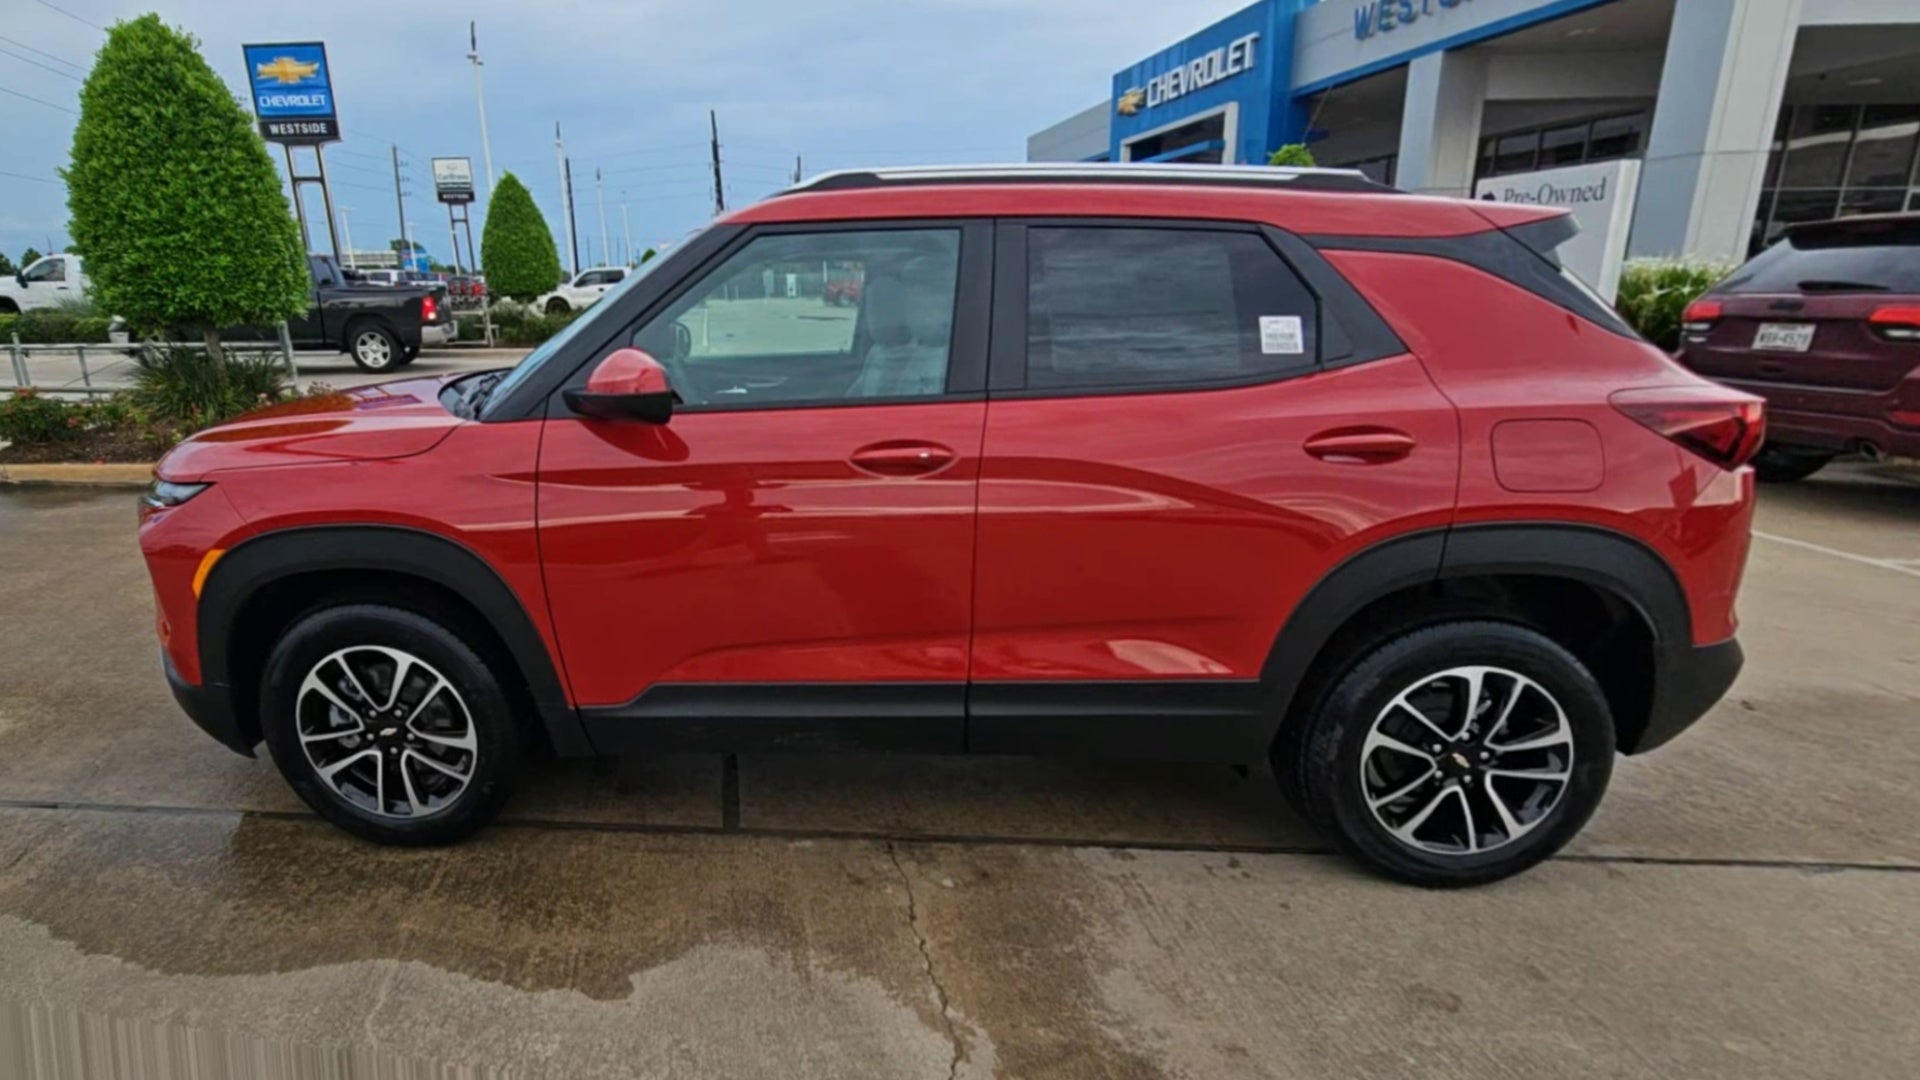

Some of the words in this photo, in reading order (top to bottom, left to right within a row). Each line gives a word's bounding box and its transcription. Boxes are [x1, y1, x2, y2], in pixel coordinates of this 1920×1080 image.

[1147, 32, 1260, 108] CHEVROLET
[259, 95, 327, 108] CHEVROLET
[269, 122, 328, 135] WESTSIDE
[1504, 178, 1607, 204] Pre-Owned
